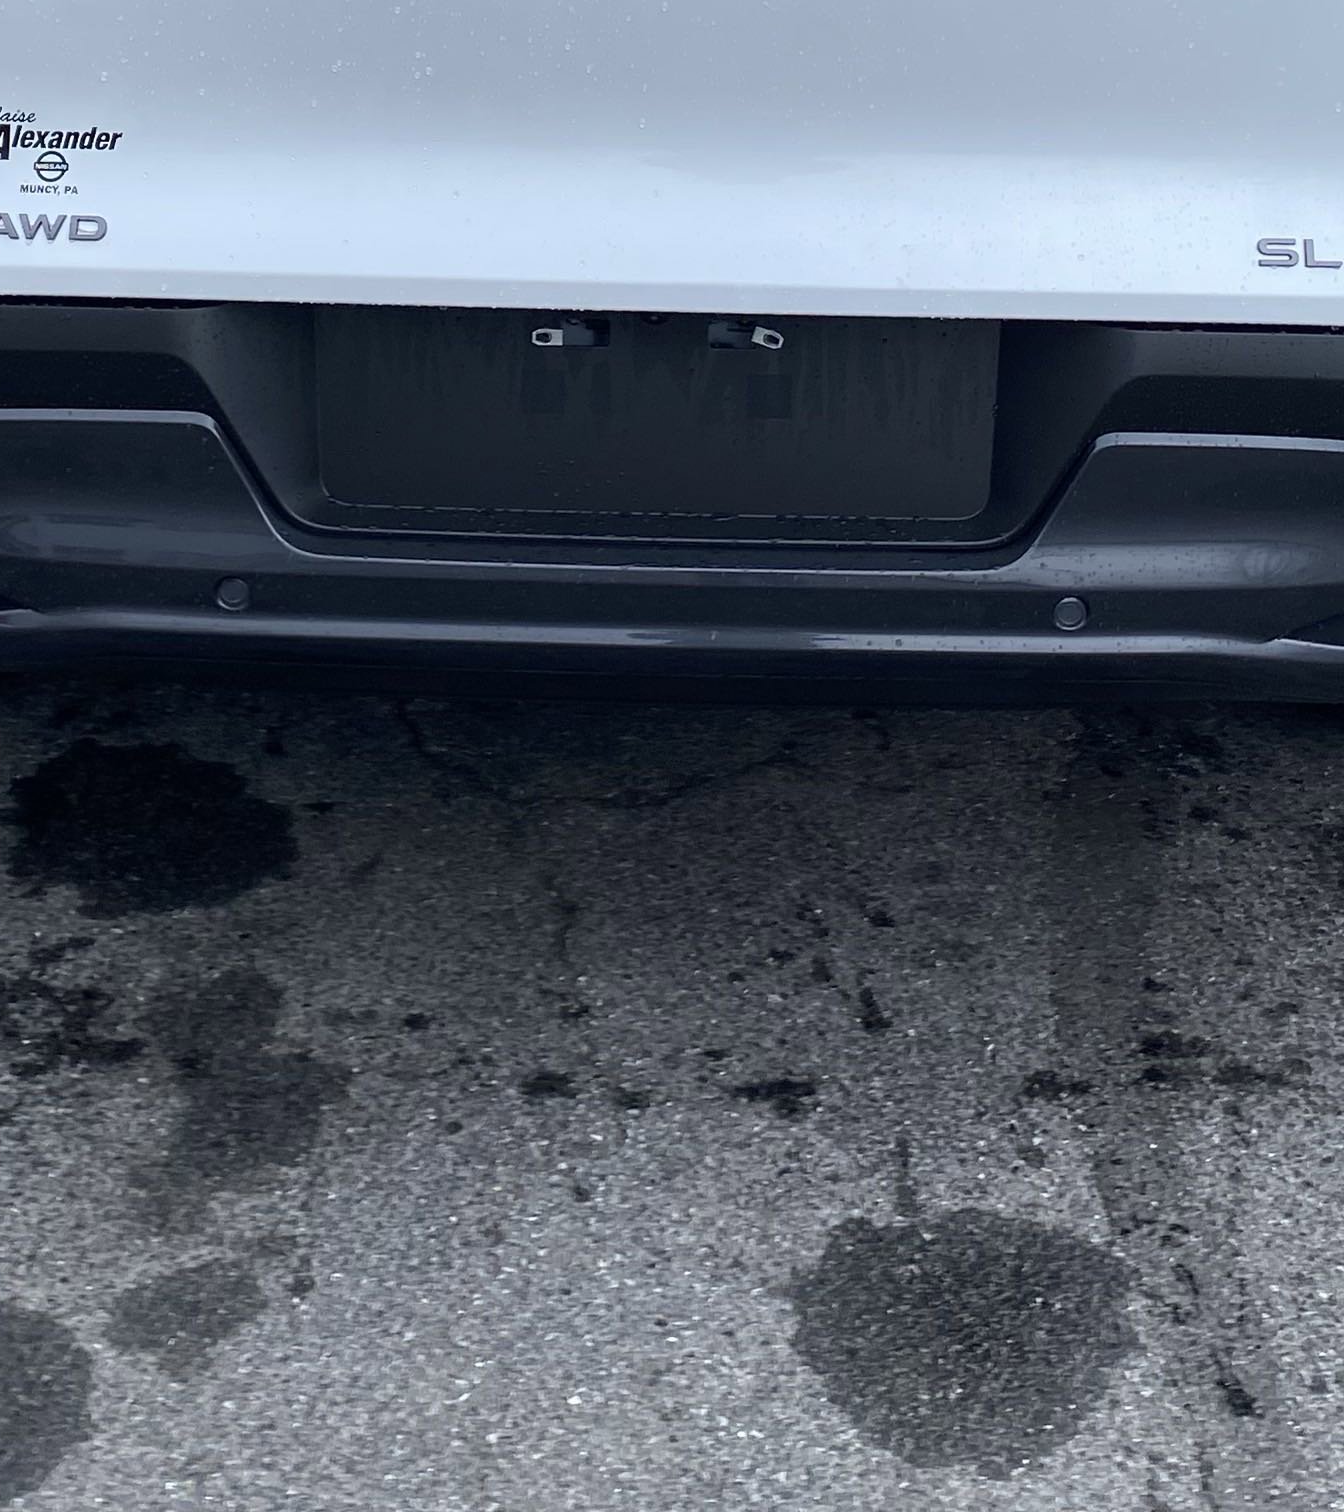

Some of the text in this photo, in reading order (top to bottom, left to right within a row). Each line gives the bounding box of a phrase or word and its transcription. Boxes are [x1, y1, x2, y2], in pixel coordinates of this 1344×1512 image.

[34, 162, 68, 171] NISSAN
[19, 184, 79, 196] MUNCY, PA
[1256, 237, 1344, 270] SL
